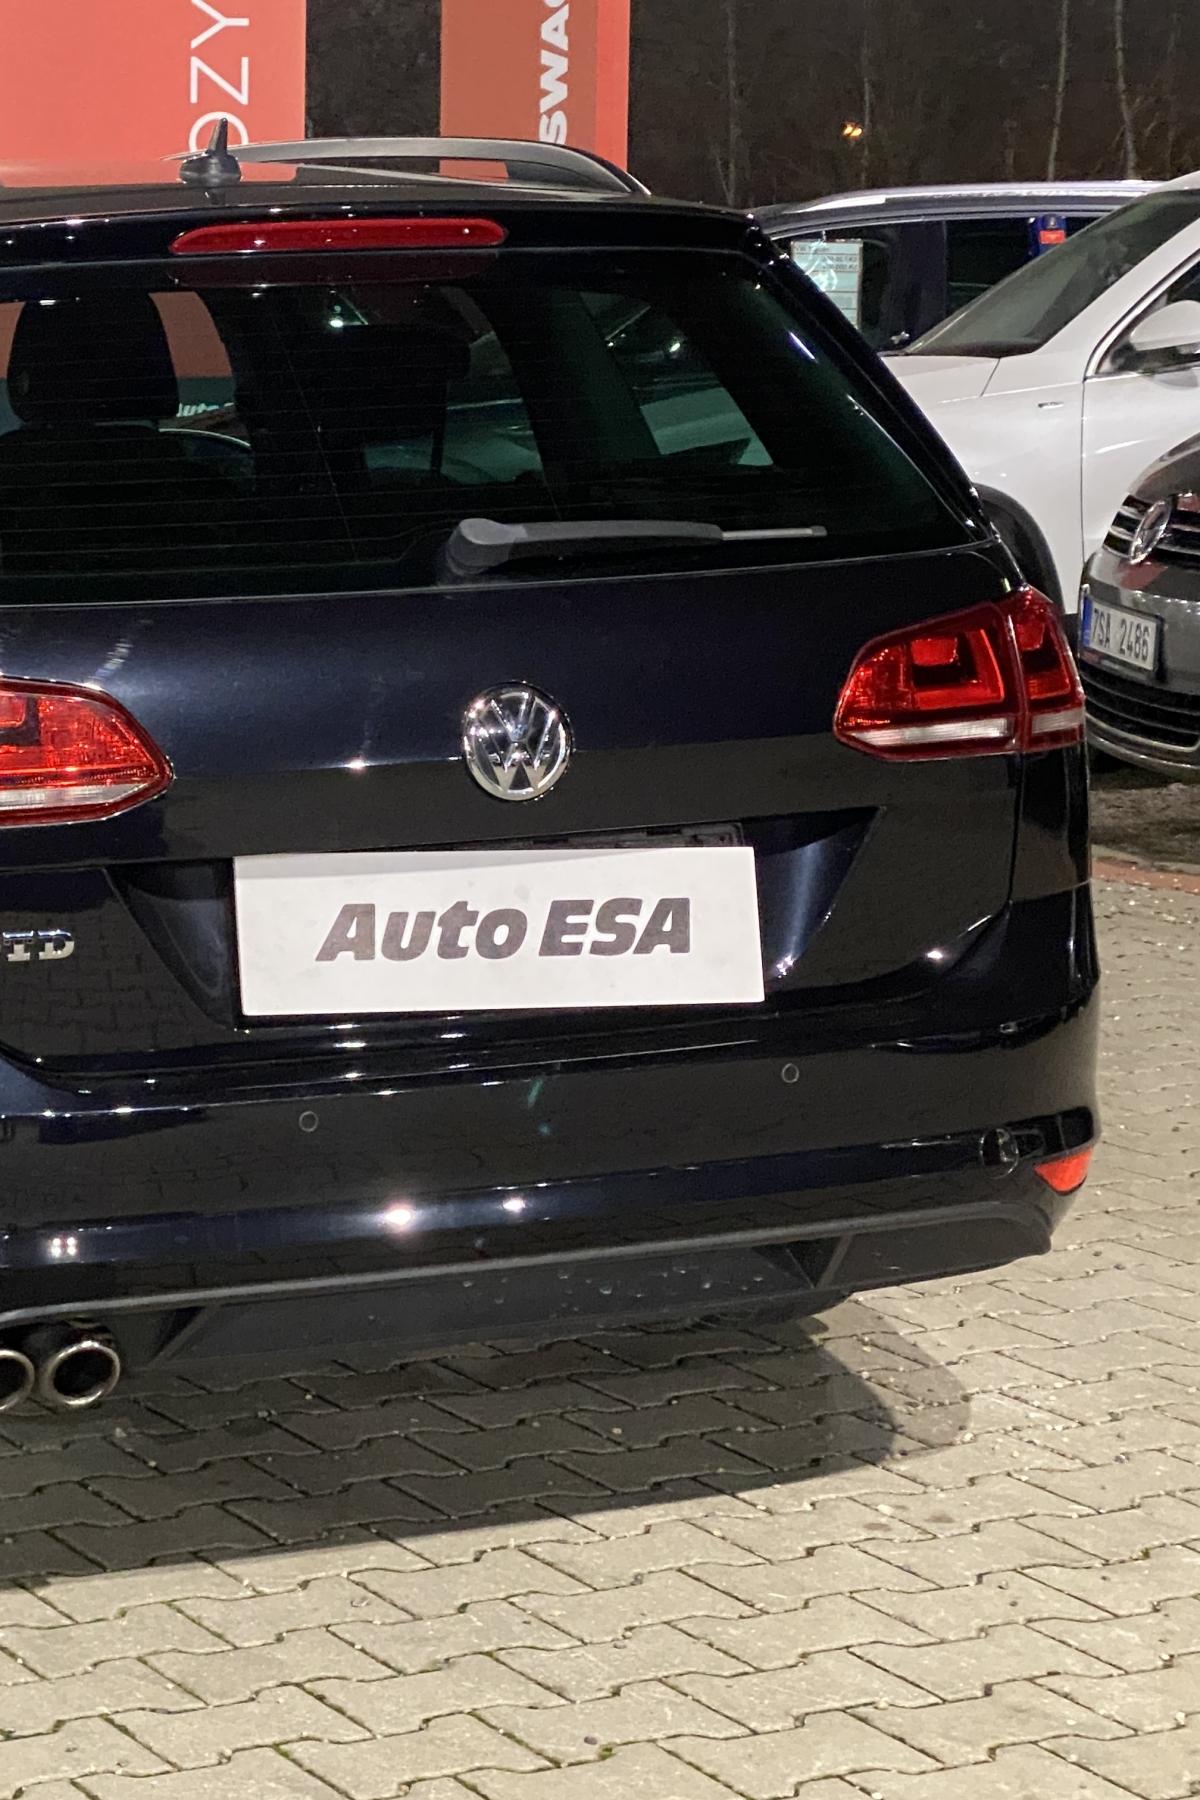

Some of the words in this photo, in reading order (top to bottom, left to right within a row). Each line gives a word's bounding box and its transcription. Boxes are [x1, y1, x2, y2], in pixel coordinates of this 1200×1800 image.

[539, 0, 569, 144] SWA
[1092, 607, 1111, 649] 7SA
[1119, 618, 1150, 662] 2486
[315, 901, 528, 961] Auto
[538, 898, 690, 956] ESA
